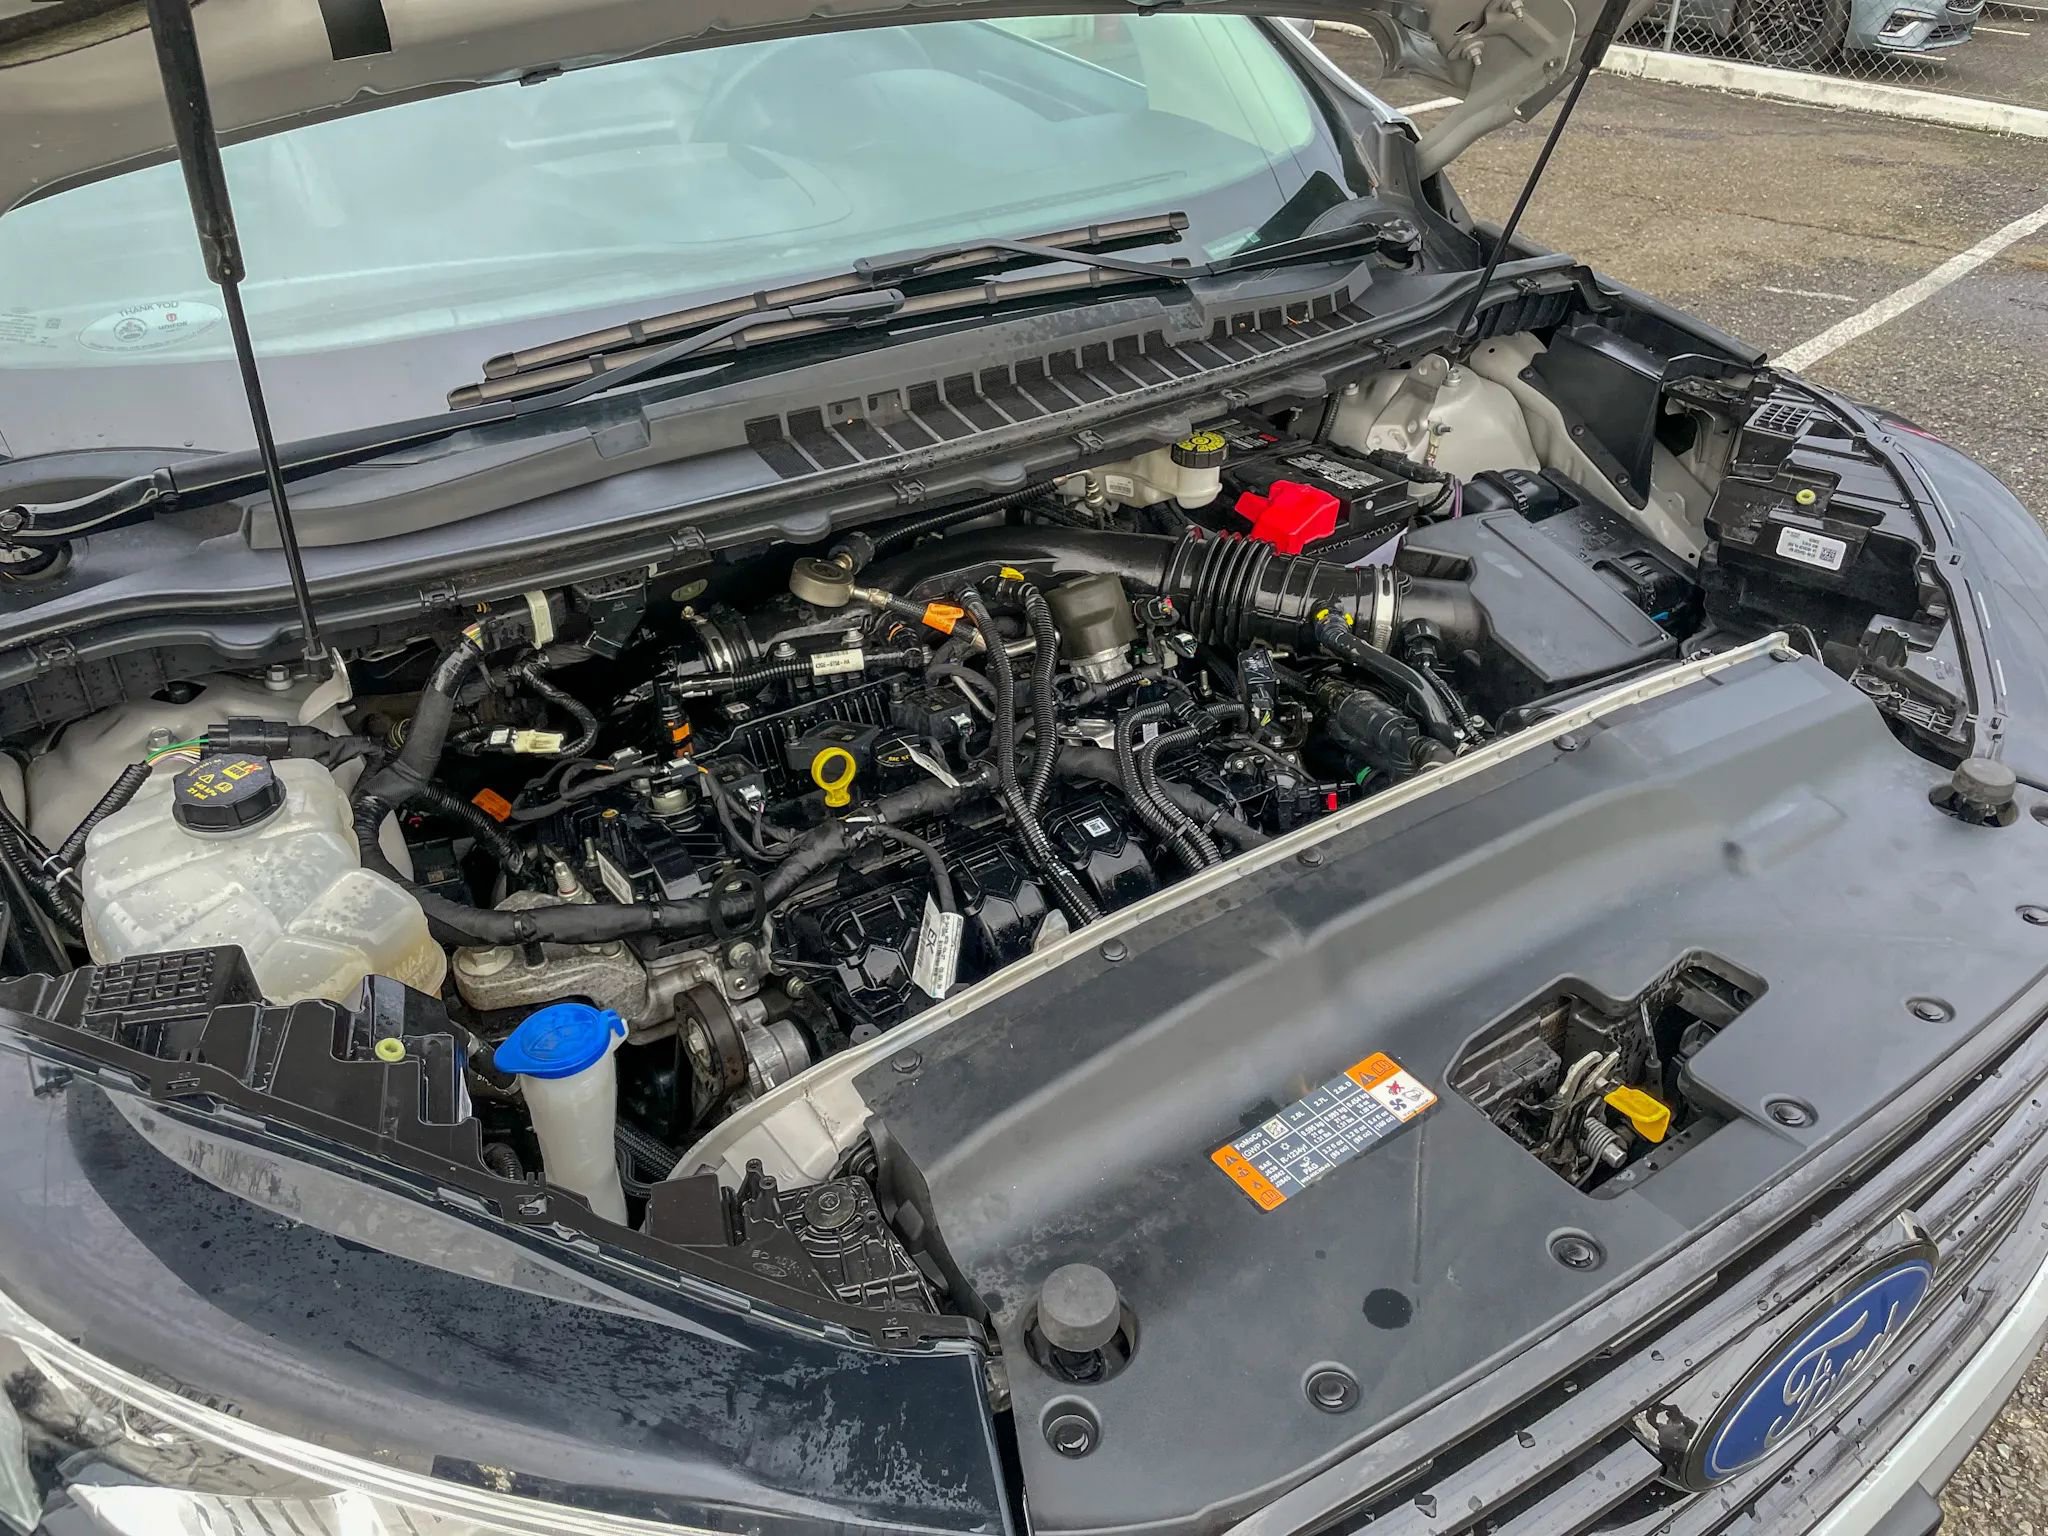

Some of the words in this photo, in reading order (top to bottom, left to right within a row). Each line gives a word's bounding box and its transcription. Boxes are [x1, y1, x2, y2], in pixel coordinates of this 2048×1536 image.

[1314, 1097, 1328, 1107] 2.7L
[1234, 1132, 1262, 1150] FoMoCo
[1241, 1143, 1263, 1158] (GWP
[1280, 1144, 1308, 1163] R-1234yf
[1258, 1160, 1272, 1170] SAE
[1303, 1163, 1319, 1175] PAG
[1764, 1300, 1900, 1449] Ford
